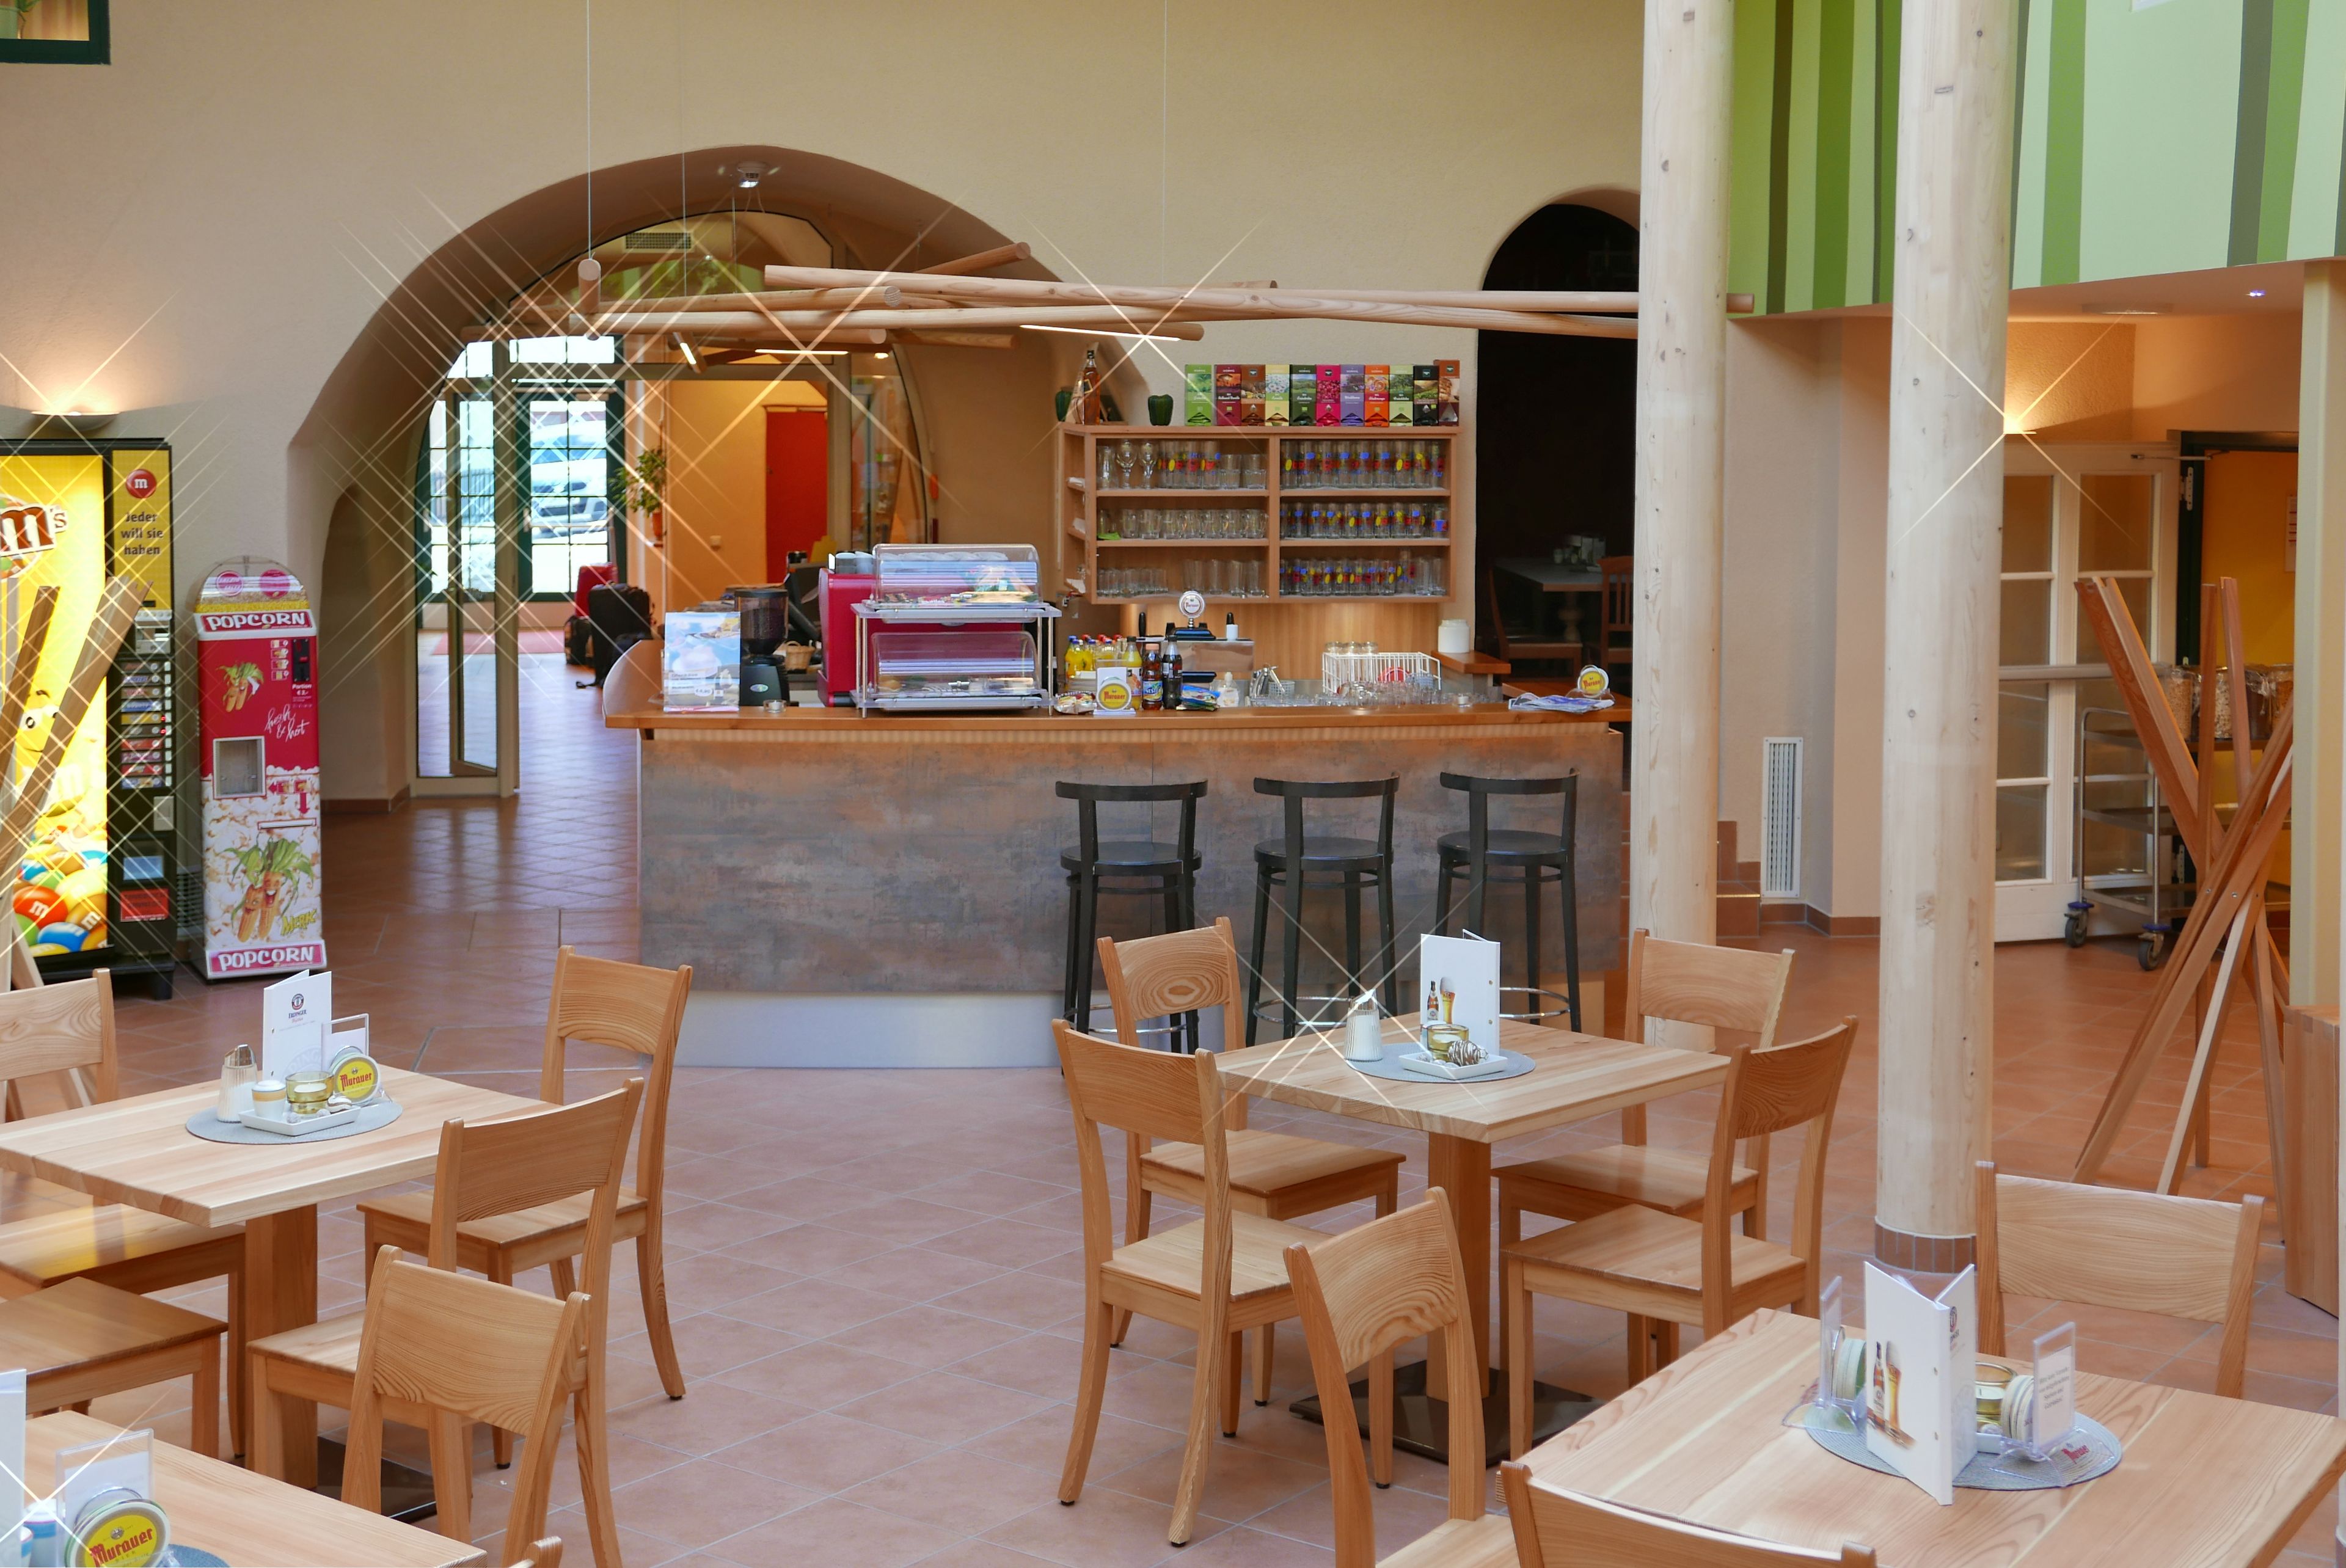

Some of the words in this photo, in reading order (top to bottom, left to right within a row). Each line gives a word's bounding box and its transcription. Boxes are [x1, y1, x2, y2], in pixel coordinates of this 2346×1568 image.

[134, 478, 148, 489] m
[126, 511, 158, 522] Jeder
[121, 528, 144, 539] will
[147, 527, 164, 539] sie
[123, 544, 160, 555] haben
[206, 612, 305, 631] POPCORN
[1103, 690, 1125, 702] Murauer
[276, 723, 286, 738] &
[285, 713, 310, 743] hot
[29, 900, 49, 916] m
[81, 911, 101, 930] m
[218, 946, 314, 971] POPCORN
[340, 1073, 372, 1091] Murauer
[89, 1528, 153, 1568] Murauer
